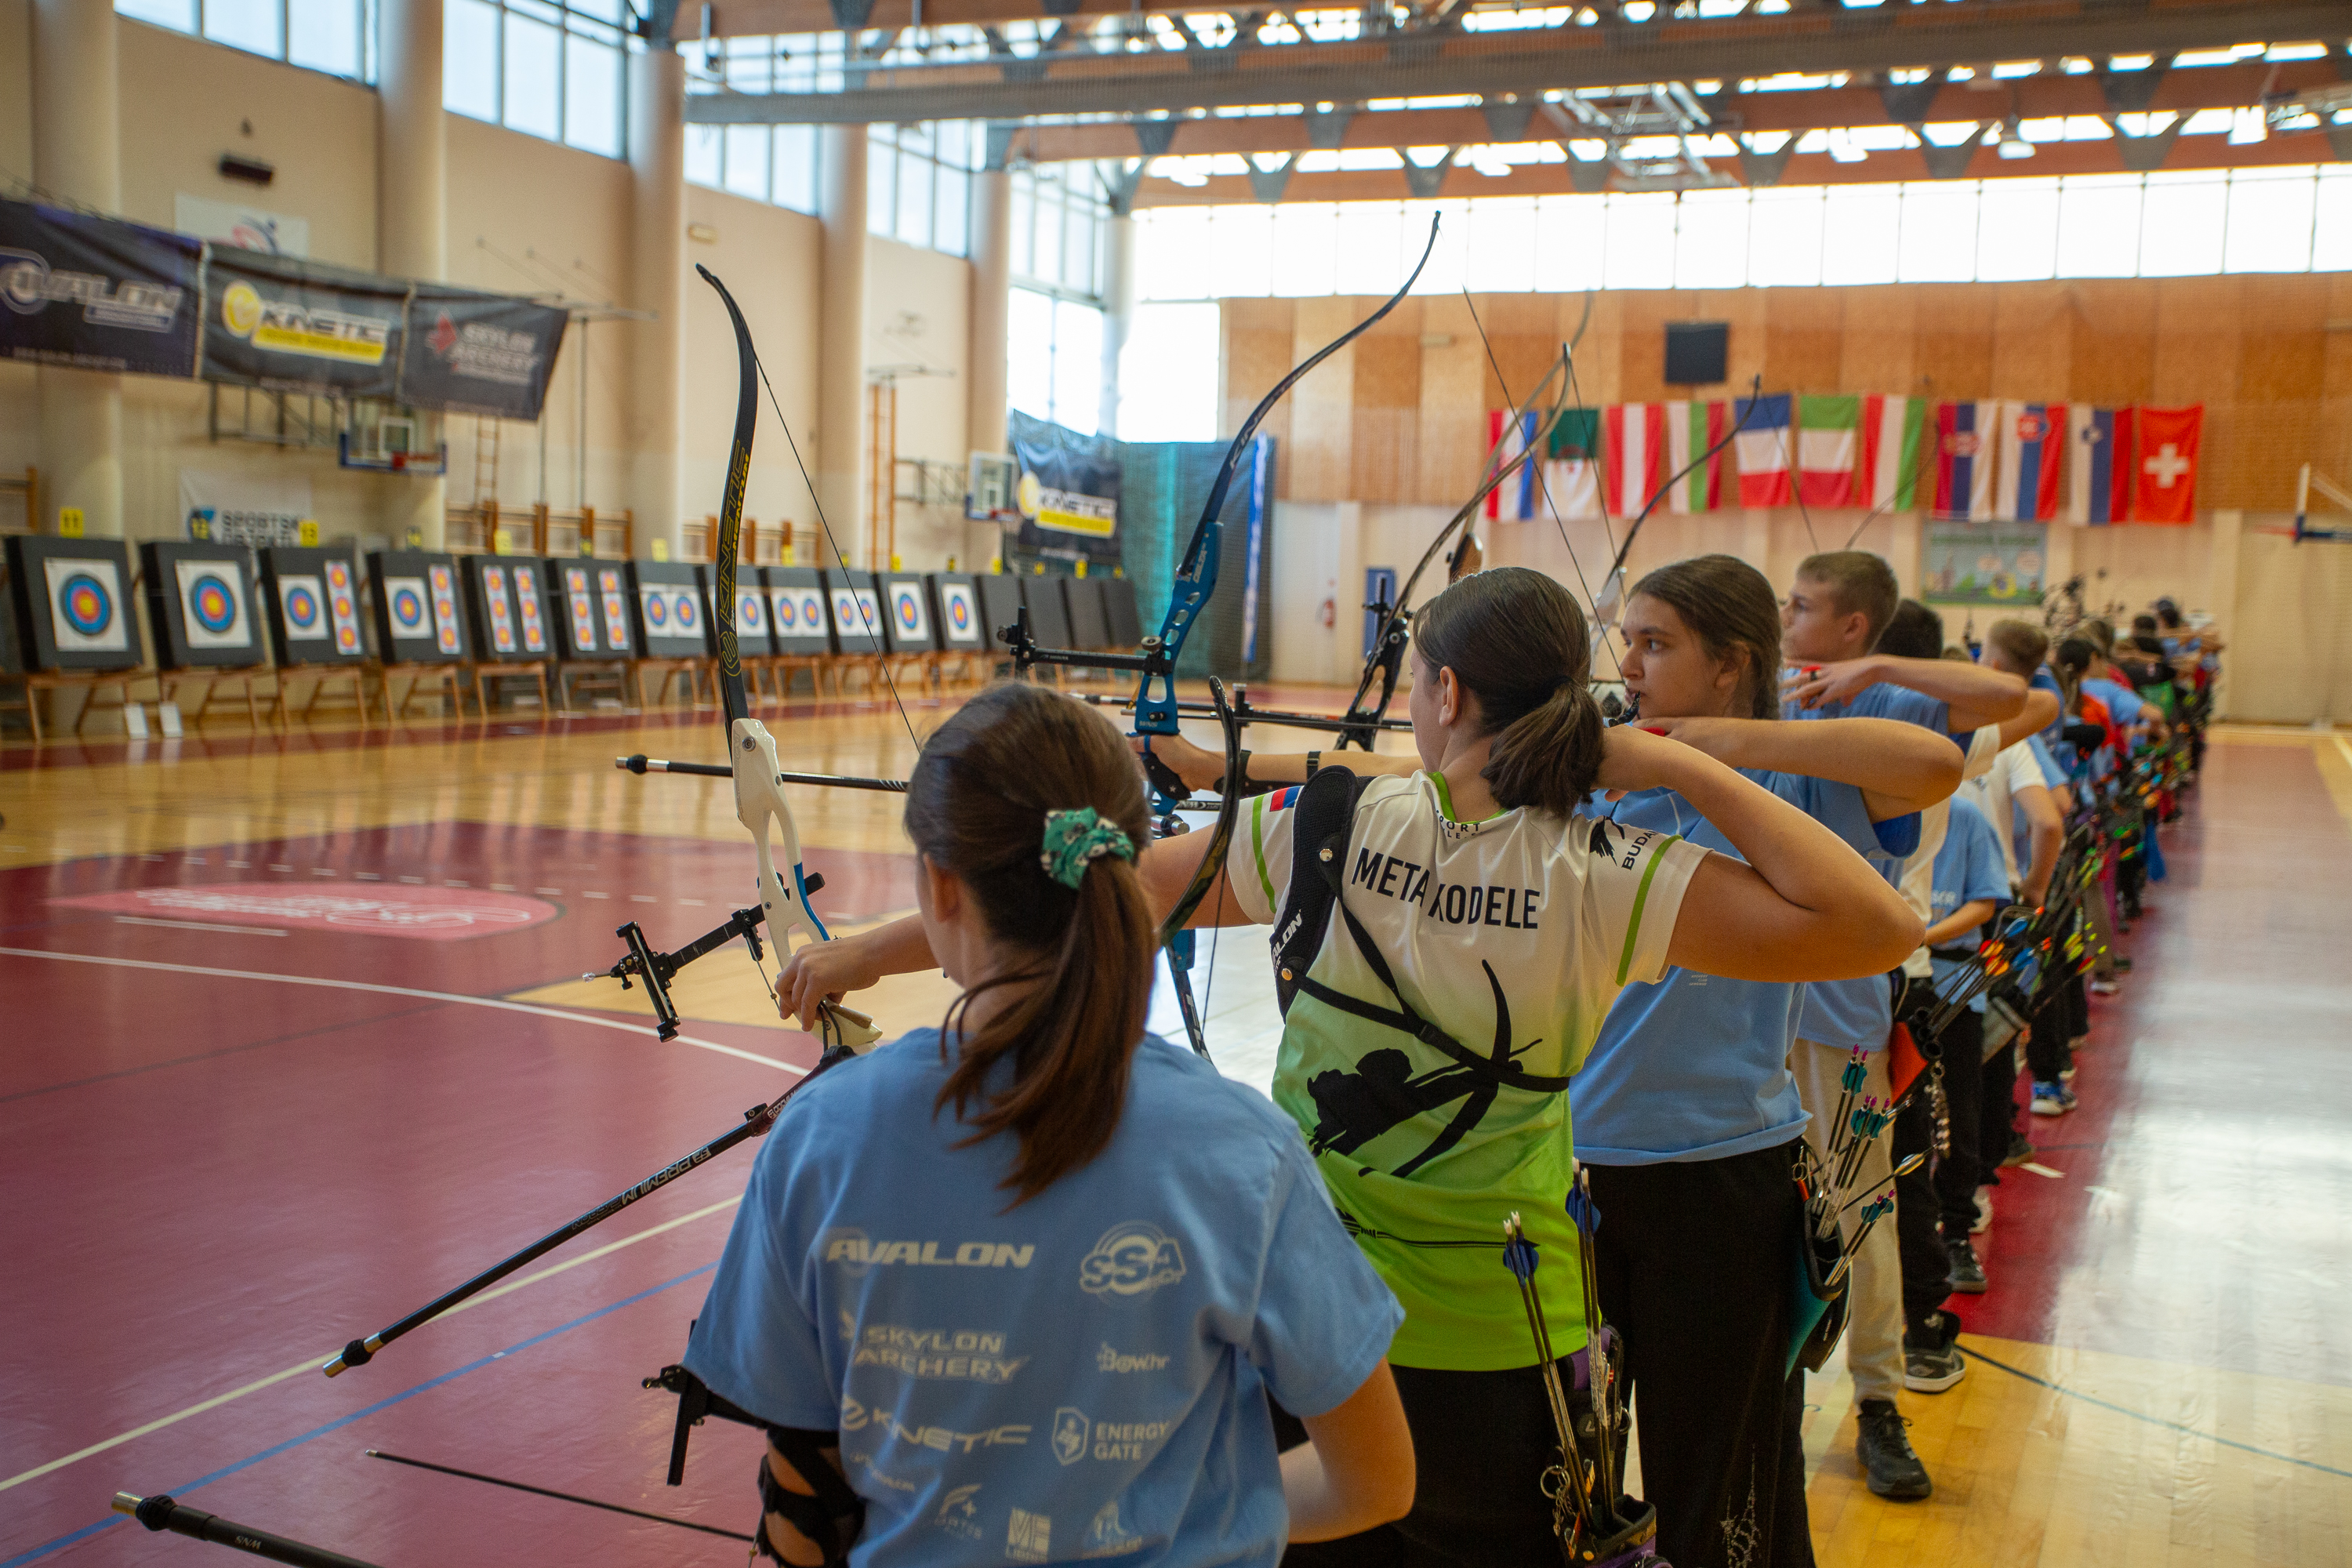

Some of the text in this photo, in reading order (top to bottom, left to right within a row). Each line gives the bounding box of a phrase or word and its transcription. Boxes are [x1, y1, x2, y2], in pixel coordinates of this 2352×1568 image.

[720, 439, 746, 625] KINETIC
[1621, 830, 1658, 870] BUDA
[1352, 848, 1430, 909] META
[1272, 913, 1301, 967] ALON
[621, 1158, 692, 1206] PREMIUM
[826, 1239, 1036, 1269] AVALON
[866, 1324, 1003, 1354] SKYLON
[854, 1348, 1030, 1381] ARCHERY
[873, 1406, 1032, 1454] KNETIC
[1095, 1421, 1170, 1441] ENERGY
[1094, 1443, 1142, 1461] GATE
[236, 1534, 262, 1550] WNS
